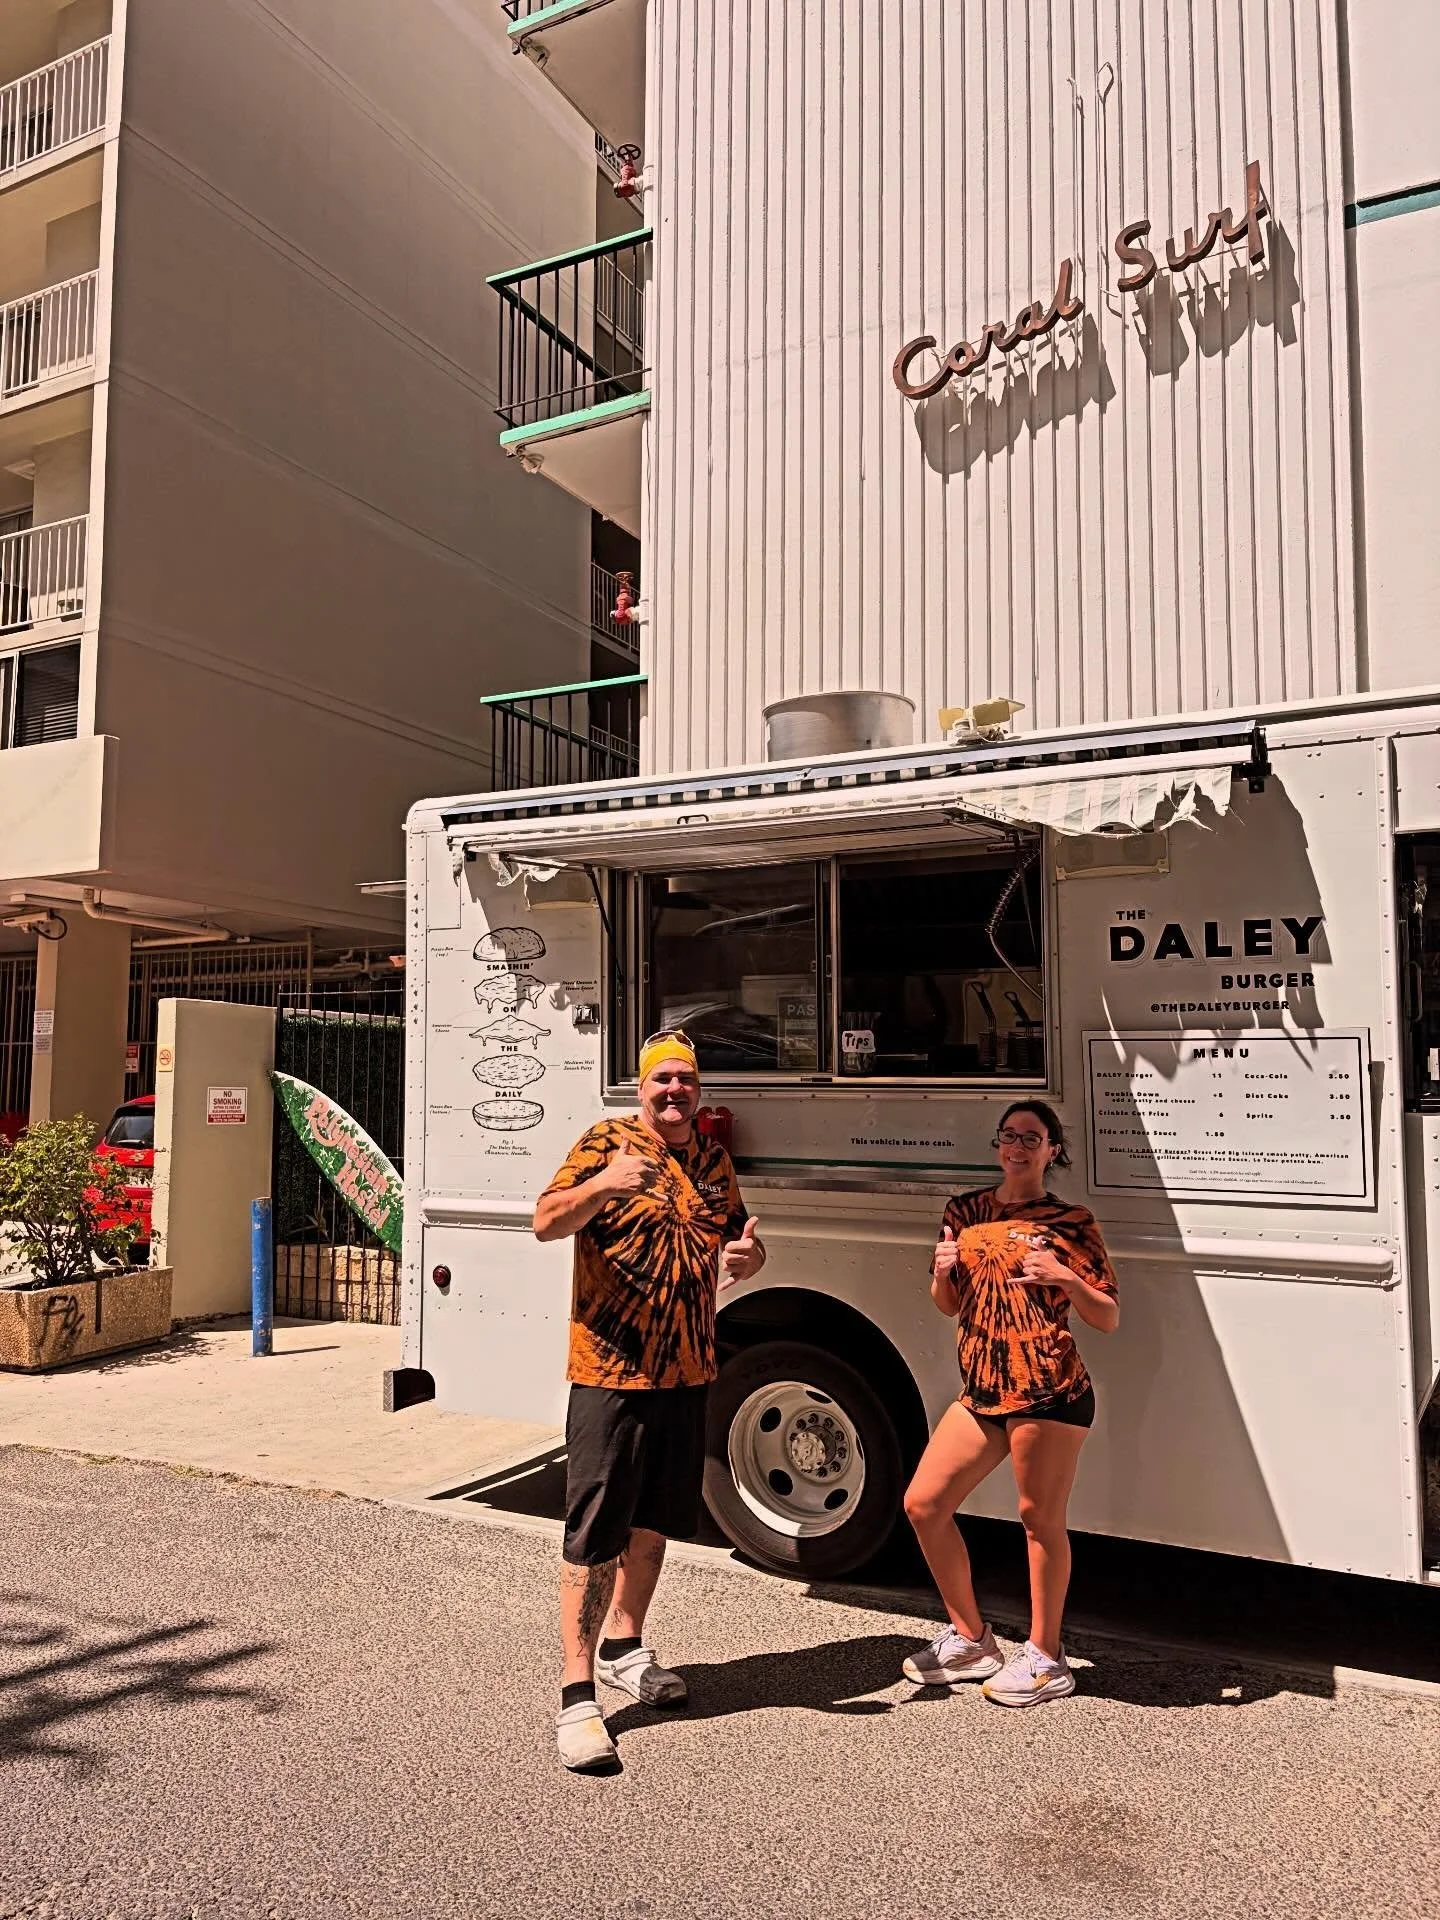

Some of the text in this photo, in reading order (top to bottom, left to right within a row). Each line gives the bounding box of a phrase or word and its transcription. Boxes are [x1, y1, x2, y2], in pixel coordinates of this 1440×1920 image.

[893, 160, 1268, 400] Coral Surf
[1116, 910, 1146, 920] THE
[1109, 916, 1325, 964] DALEY
[486, 962, 534, 971] SMASHIN'
[1221, 972, 1315, 990] BURGER
[1150, 1000, 1290, 1013] @THEDALEYBURGER
[844, 1032, 870, 1050] Tips
[1193, 1048, 1250, 1058] MENU
[304, 1095, 389, 1196] Polynesian
[334, 1157, 391, 1230] Hostel
